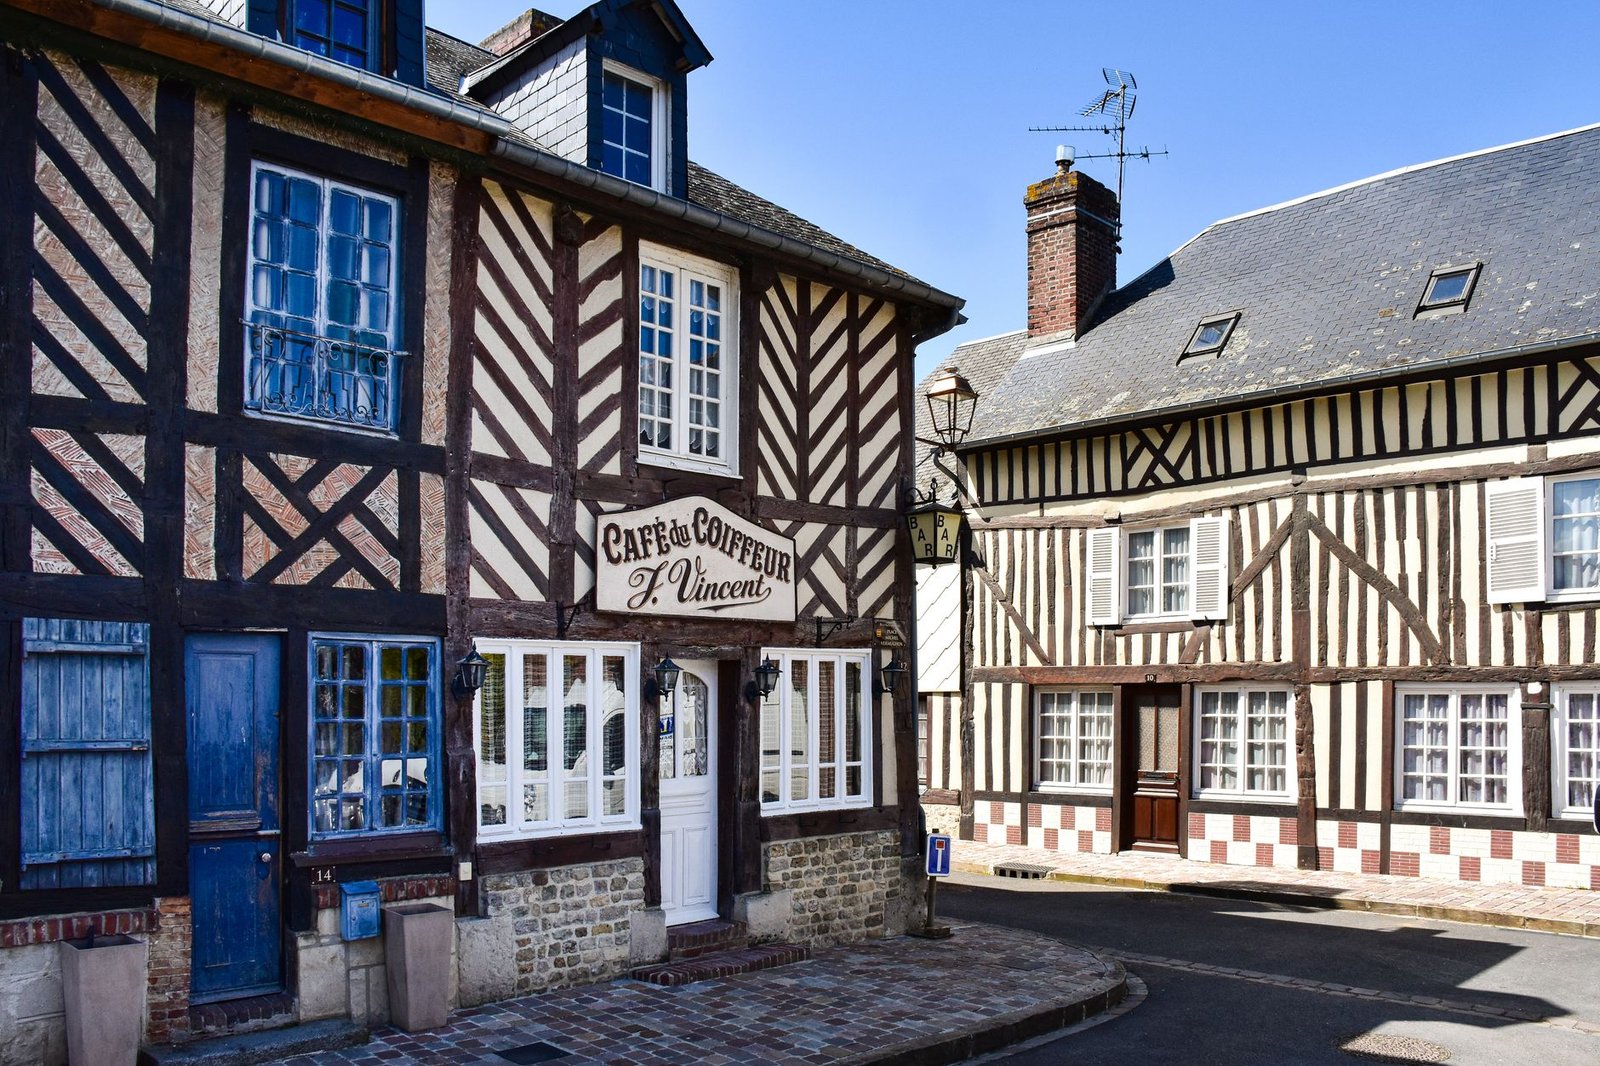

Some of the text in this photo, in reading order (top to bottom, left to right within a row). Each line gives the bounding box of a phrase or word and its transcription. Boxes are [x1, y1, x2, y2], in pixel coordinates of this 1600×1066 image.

[602, 506, 791, 583] CAFÉ du COIFFEUR
[909, 516, 933, 556] BAR
[937, 514, 953, 557] BAR
[668, 555, 771, 611] Vincent
[317, 869, 332, 882] 14
